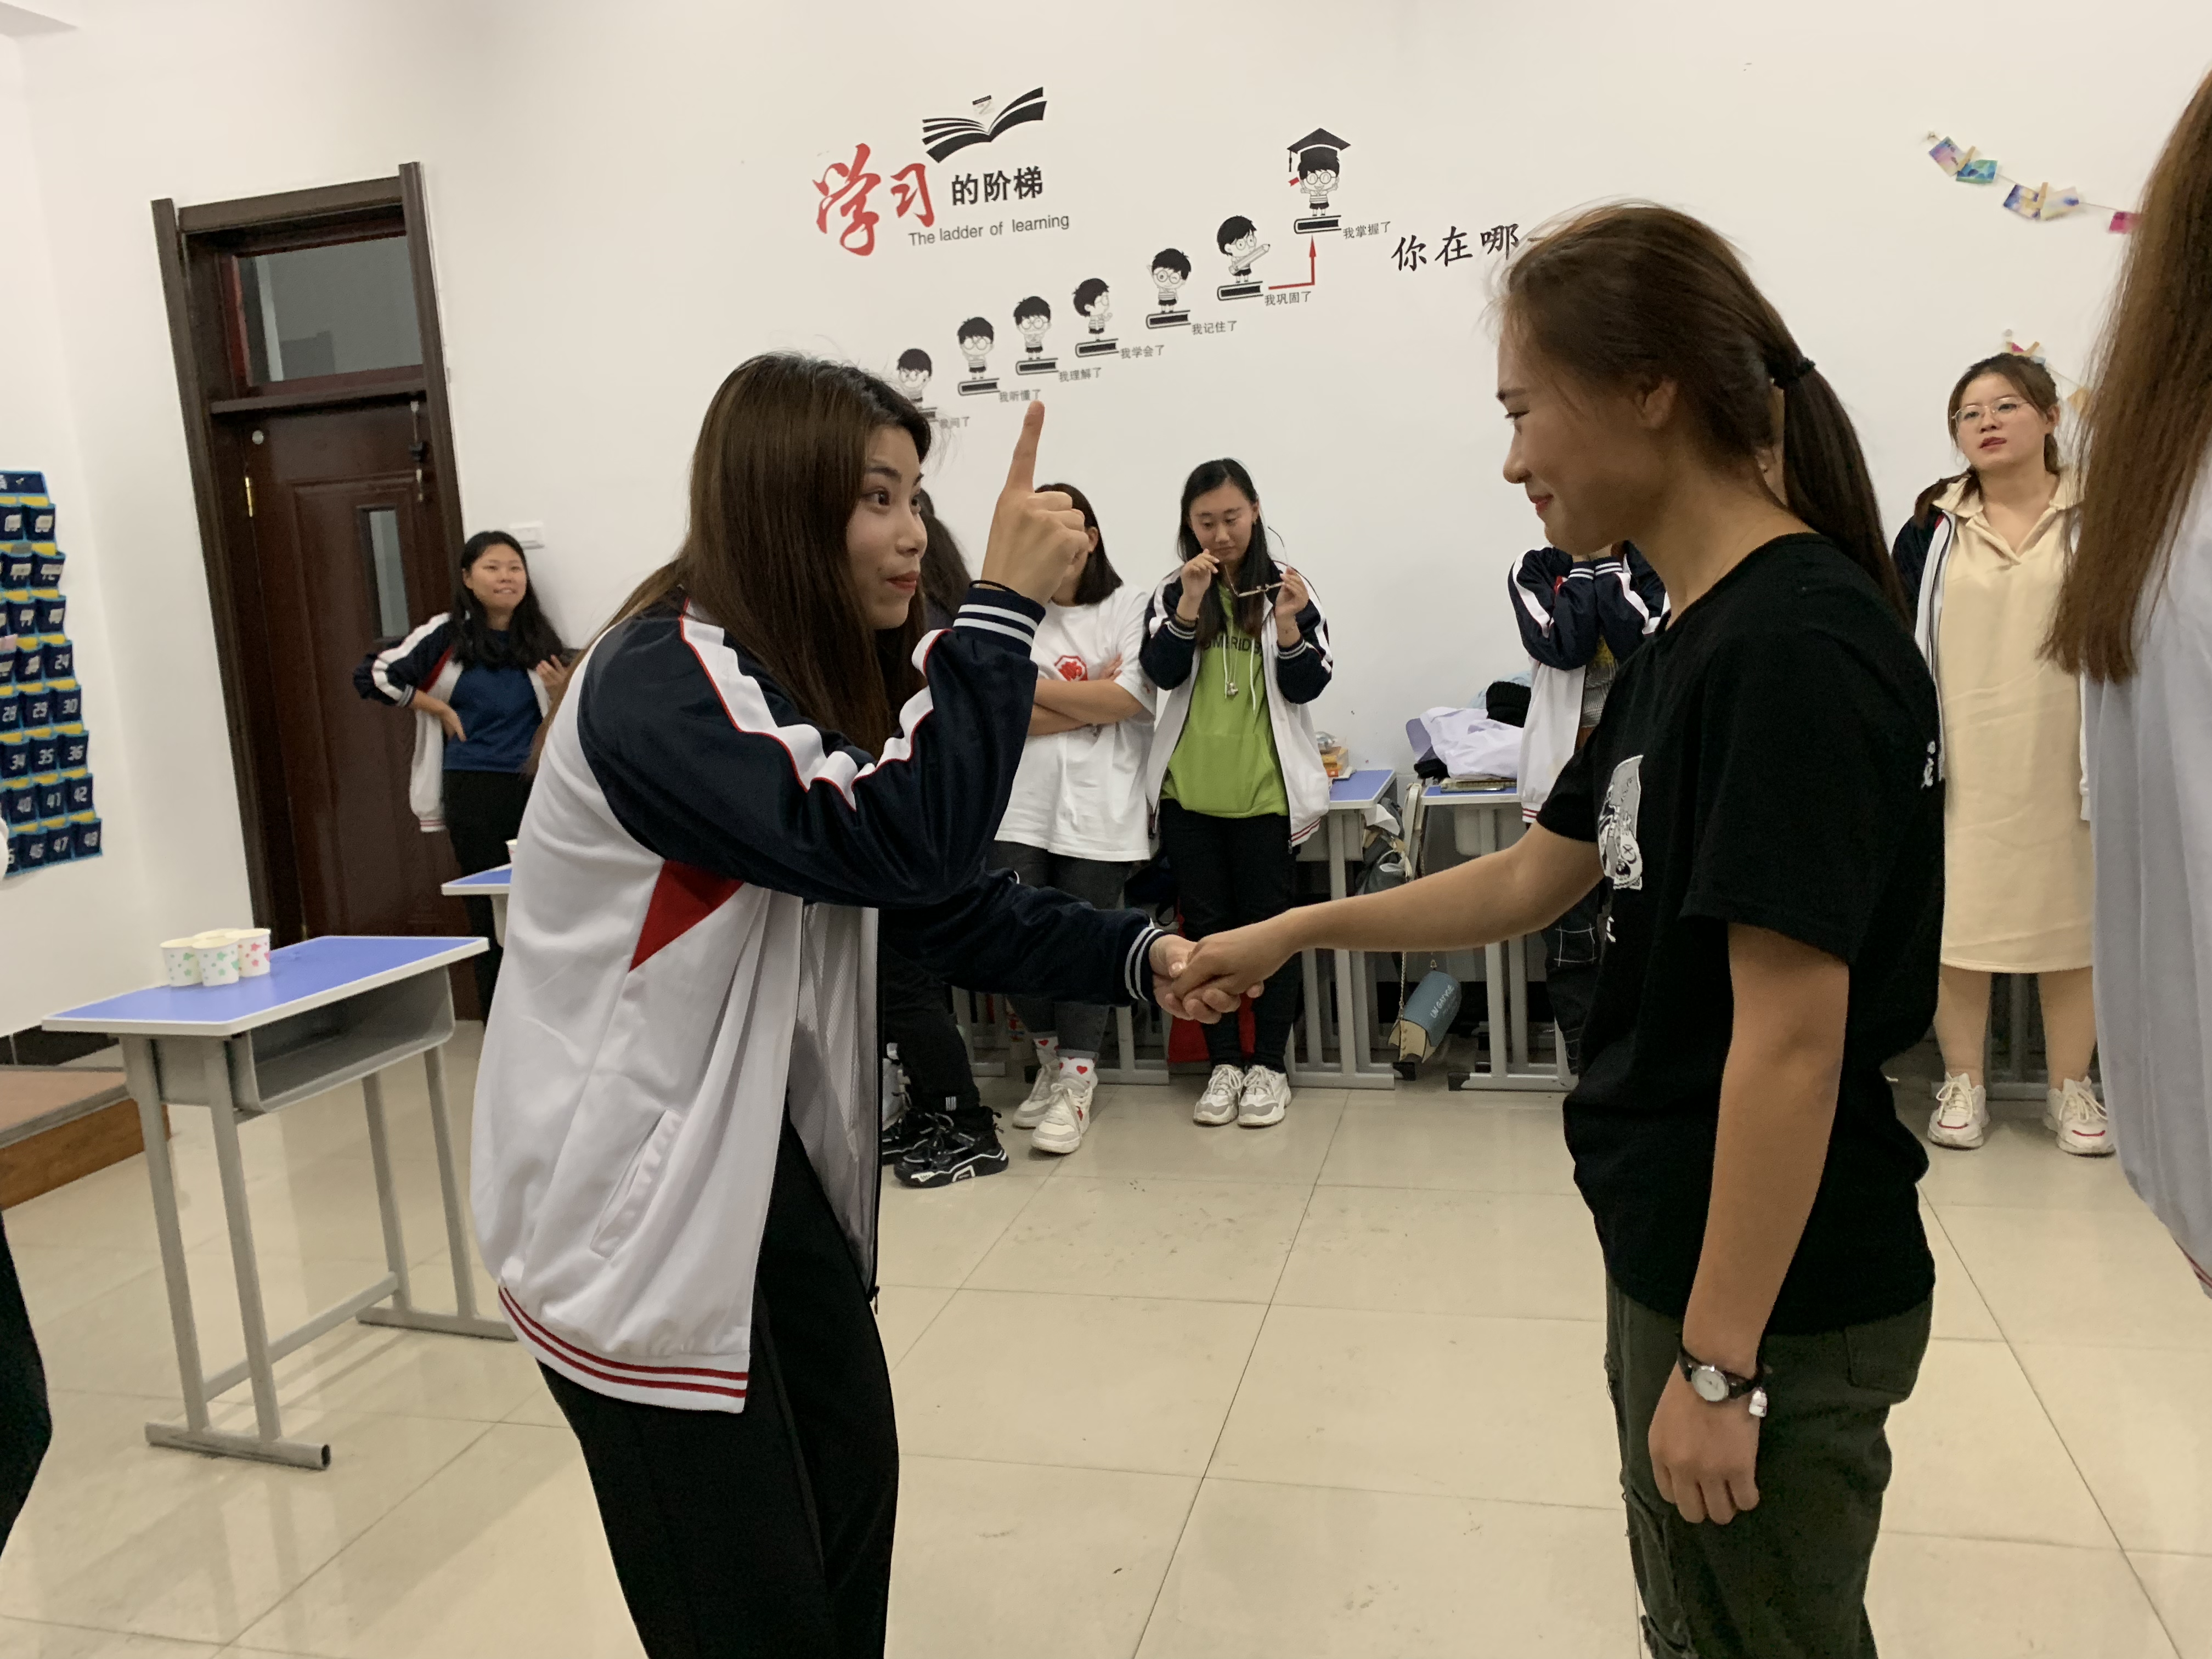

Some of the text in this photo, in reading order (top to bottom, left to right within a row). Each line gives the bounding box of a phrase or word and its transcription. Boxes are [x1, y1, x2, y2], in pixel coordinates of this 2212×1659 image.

[812, 143, 1043, 257] 学习 的阶梯
[908, 214, 1070, 246] The ladder of learning
[1342, 221, 1391, 240] 我掌握了
[1264, 291, 1312, 307] 我巩固了
[1191, 320, 1237, 335] 我记住了
[1120, 345, 1165, 359] 我学会了
[1058, 367, 1102, 382] 我理解了
[63, 698, 78, 714] 30
[38, 748, 54, 765] 35
[68, 745, 83, 761] 36
[47, 792, 61, 808] 41
[74, 786, 88, 802] 42
[54, 837, 69, 853] 47
